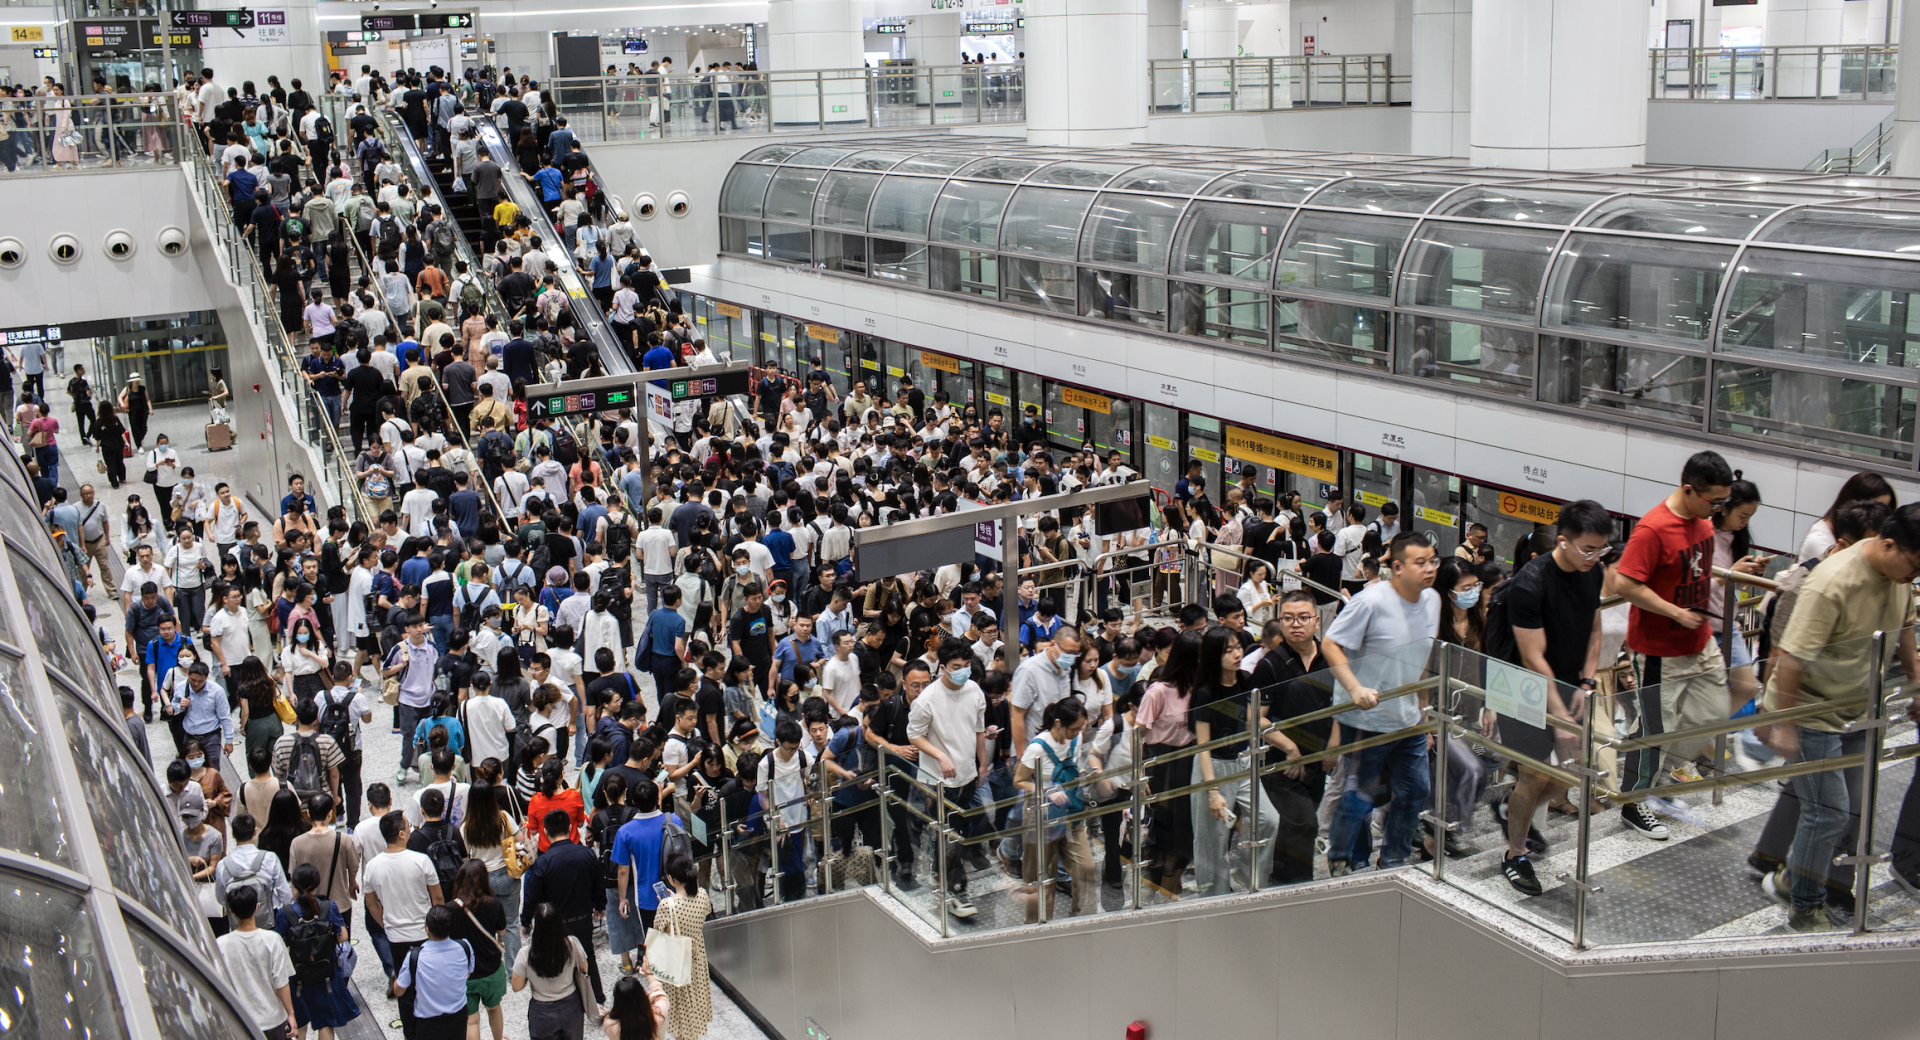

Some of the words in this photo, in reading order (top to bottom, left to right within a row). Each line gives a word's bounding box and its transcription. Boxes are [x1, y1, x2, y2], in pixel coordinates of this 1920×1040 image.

[259, 13, 282, 23] 11号线
[930, 356, 957, 369] 此侧站台不上客
[551, 400, 561, 408] 出
[1073, 392, 1108, 409] 此侧站台不上客
[1230, 436, 1334, 471] 换乘11号线的乘客请前往站厅换乘
[1523, 465, 1548, 478] 终点站
